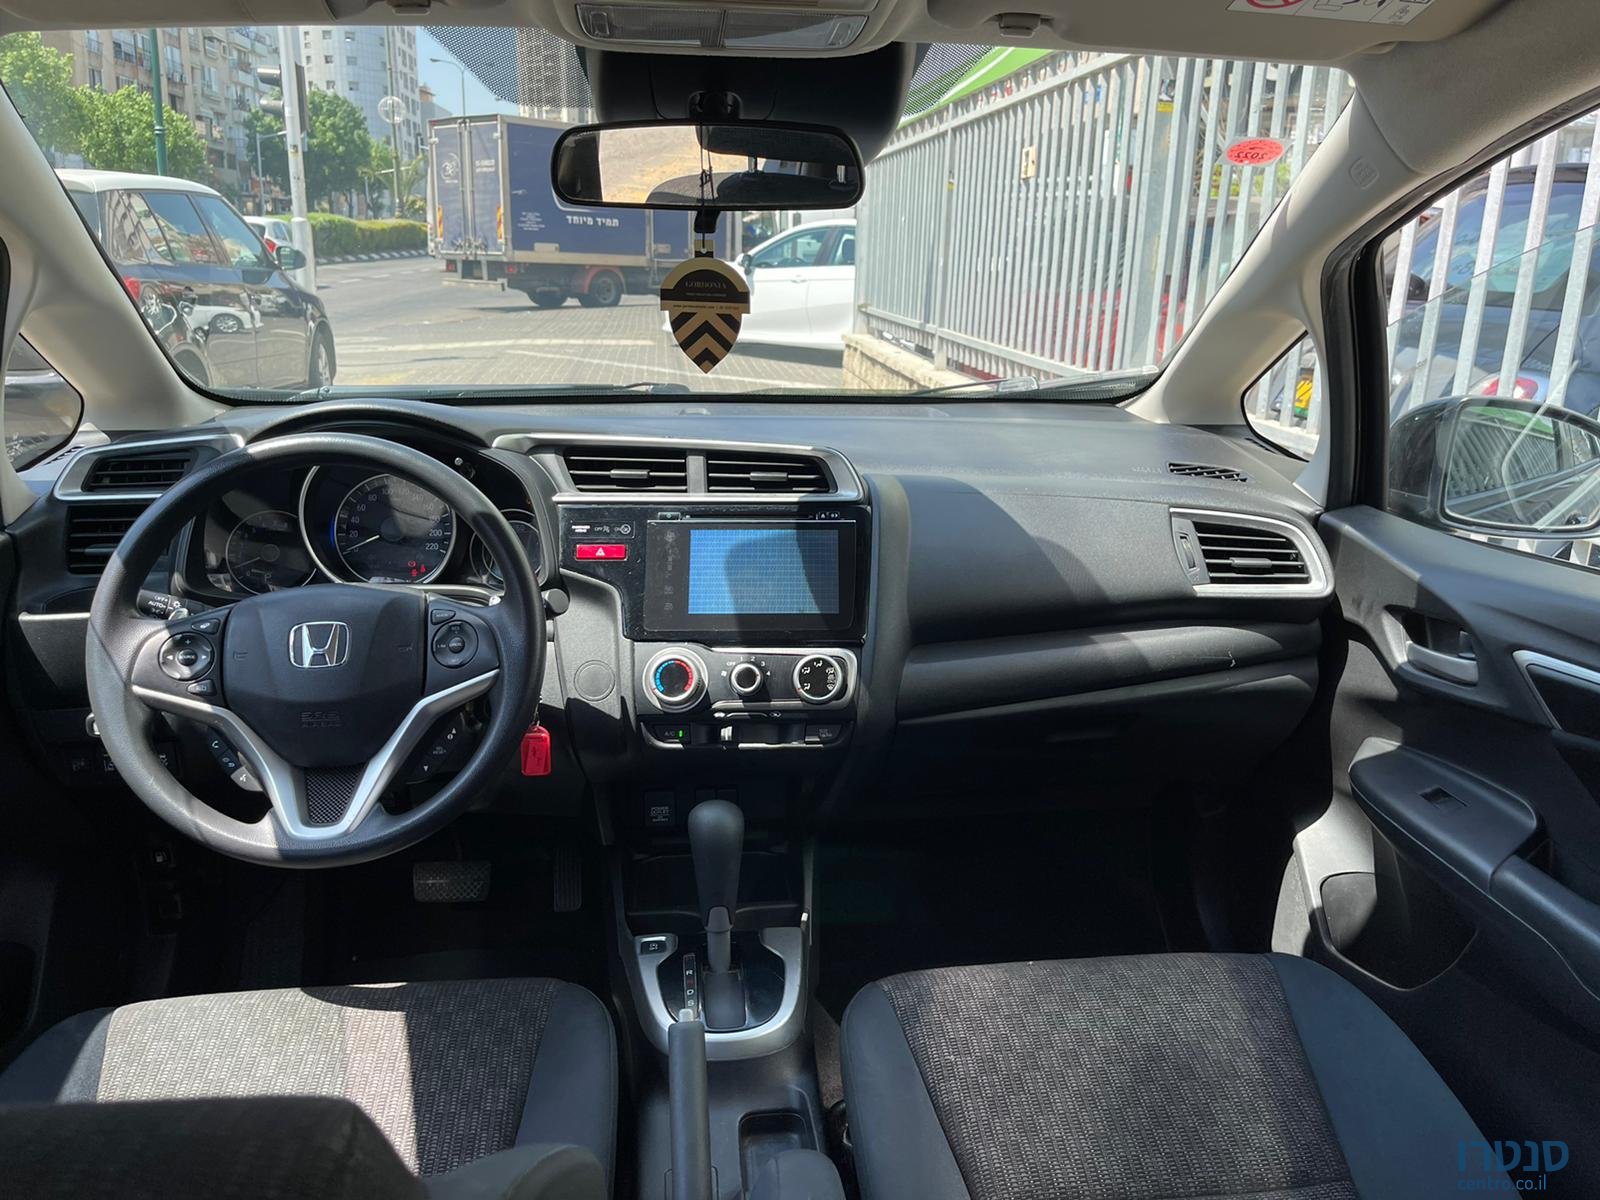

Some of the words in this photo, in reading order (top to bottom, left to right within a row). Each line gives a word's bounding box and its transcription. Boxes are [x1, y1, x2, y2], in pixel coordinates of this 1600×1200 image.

[566, 215, 594, 226] מיוחד
[595, 217, 619, 228] תמיד
[349, 530, 358, 538] 20
[429, 529, 442, 537] 200
[425, 543, 438, 551] 220
[148, 600, 163, 608] AUTO
